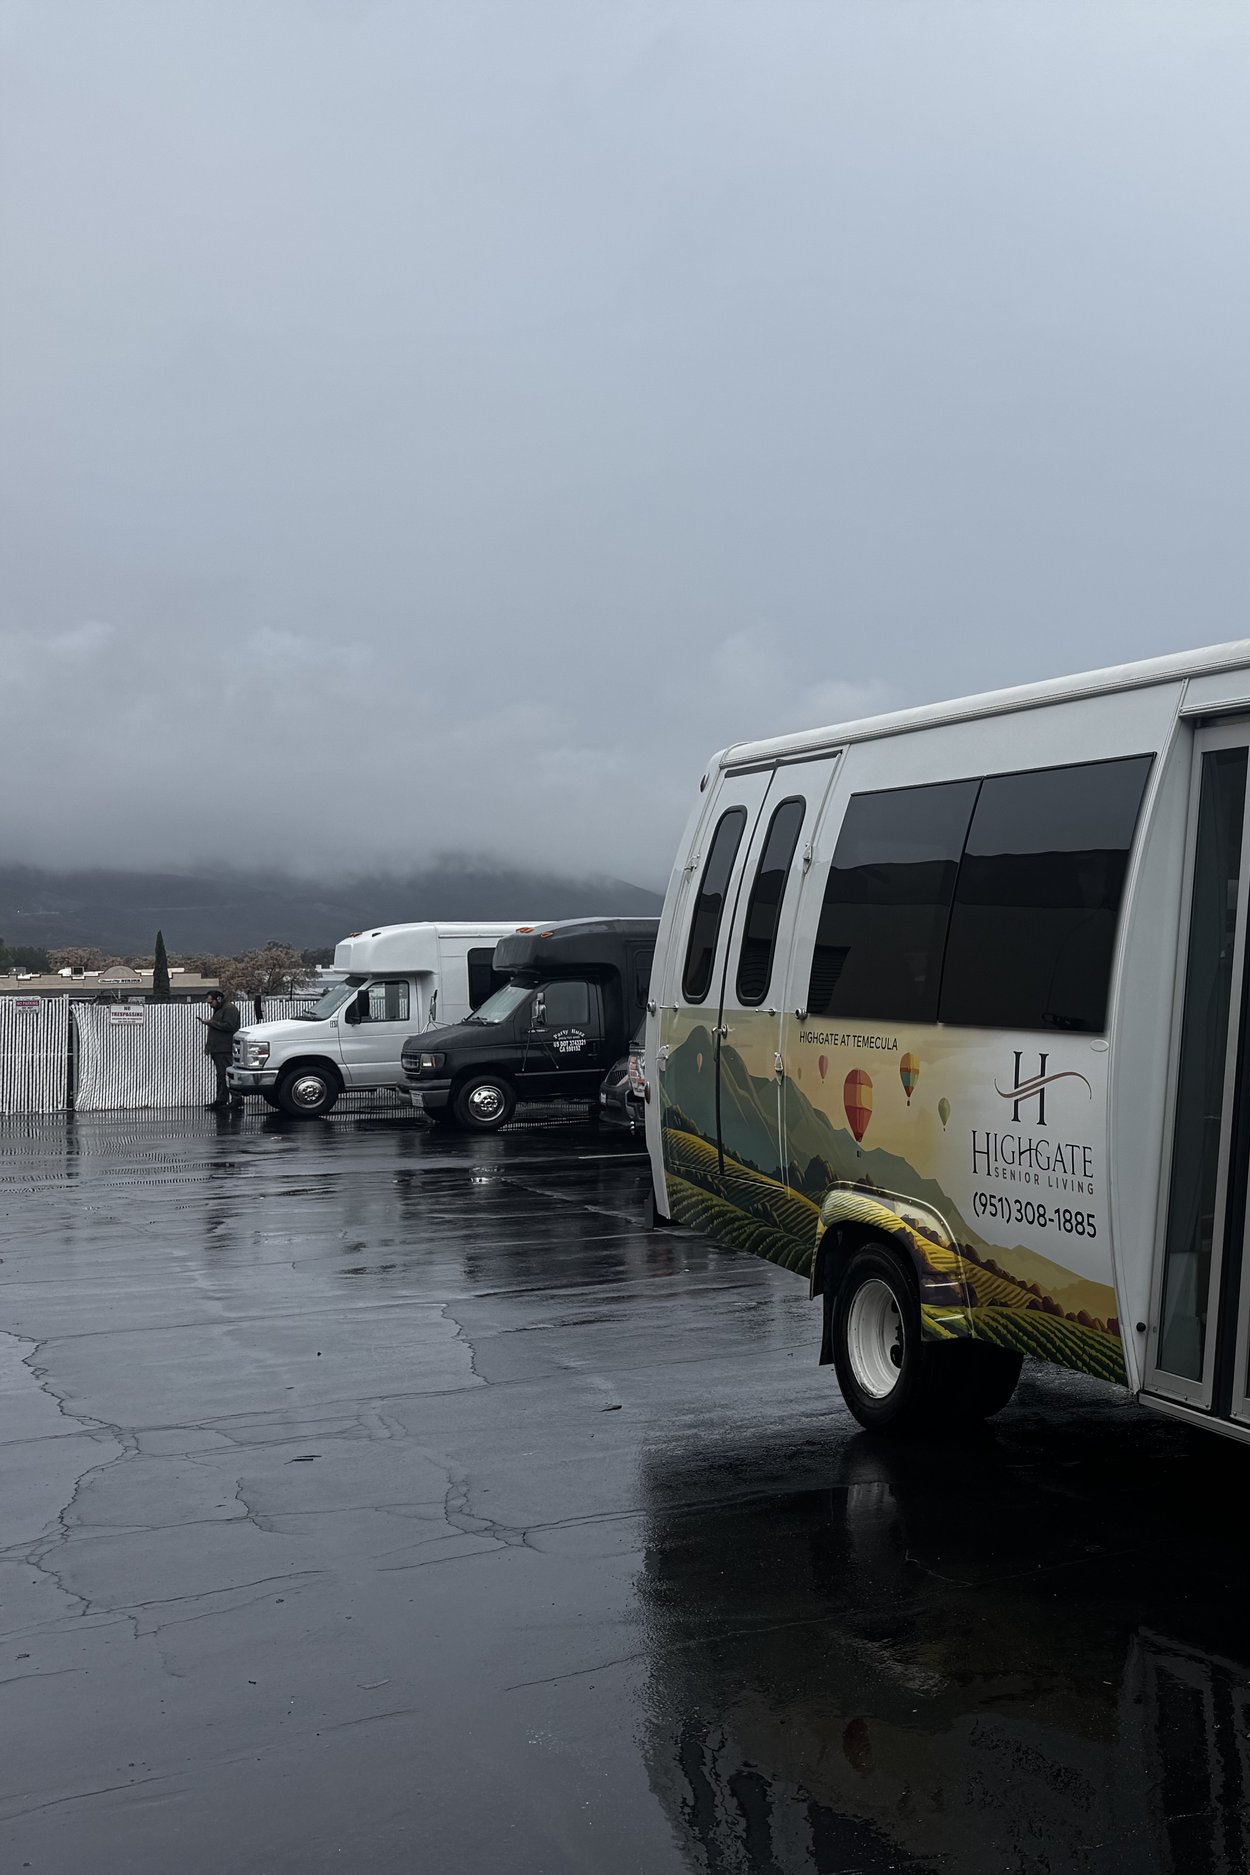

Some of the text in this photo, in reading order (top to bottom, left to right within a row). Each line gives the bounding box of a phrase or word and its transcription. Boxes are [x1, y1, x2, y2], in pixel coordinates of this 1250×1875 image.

[799, 1030, 898, 1051] HIGHGATE AT TEMECULA
[971, 1130, 1094, 1178] HIGHGATE
[994, 1166, 1094, 1195] SENIOR LIVING
